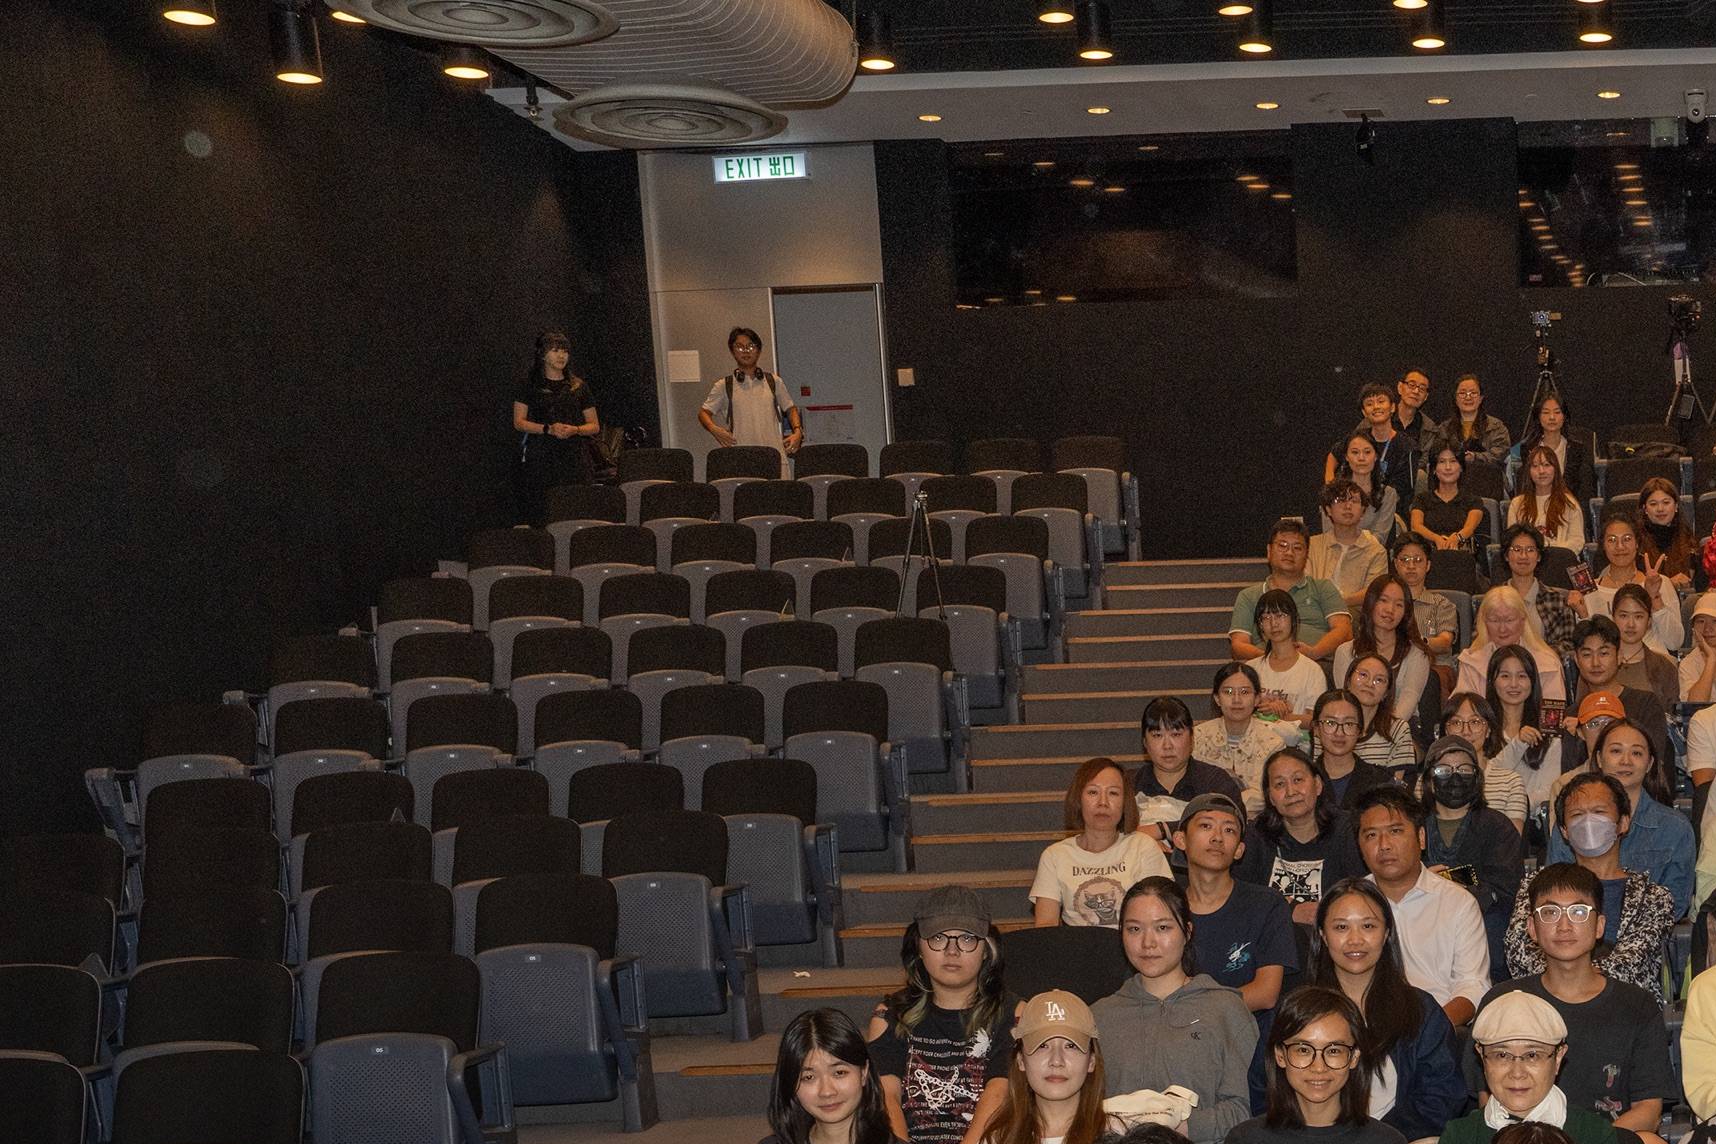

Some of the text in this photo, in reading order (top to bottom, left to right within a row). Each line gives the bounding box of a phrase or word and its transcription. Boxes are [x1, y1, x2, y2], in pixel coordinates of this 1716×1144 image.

[725, 155, 795, 179] EXIT 出口
[1072, 861, 1127, 877] DAZZLING
[1046, 1001, 1065, 1020] LA
